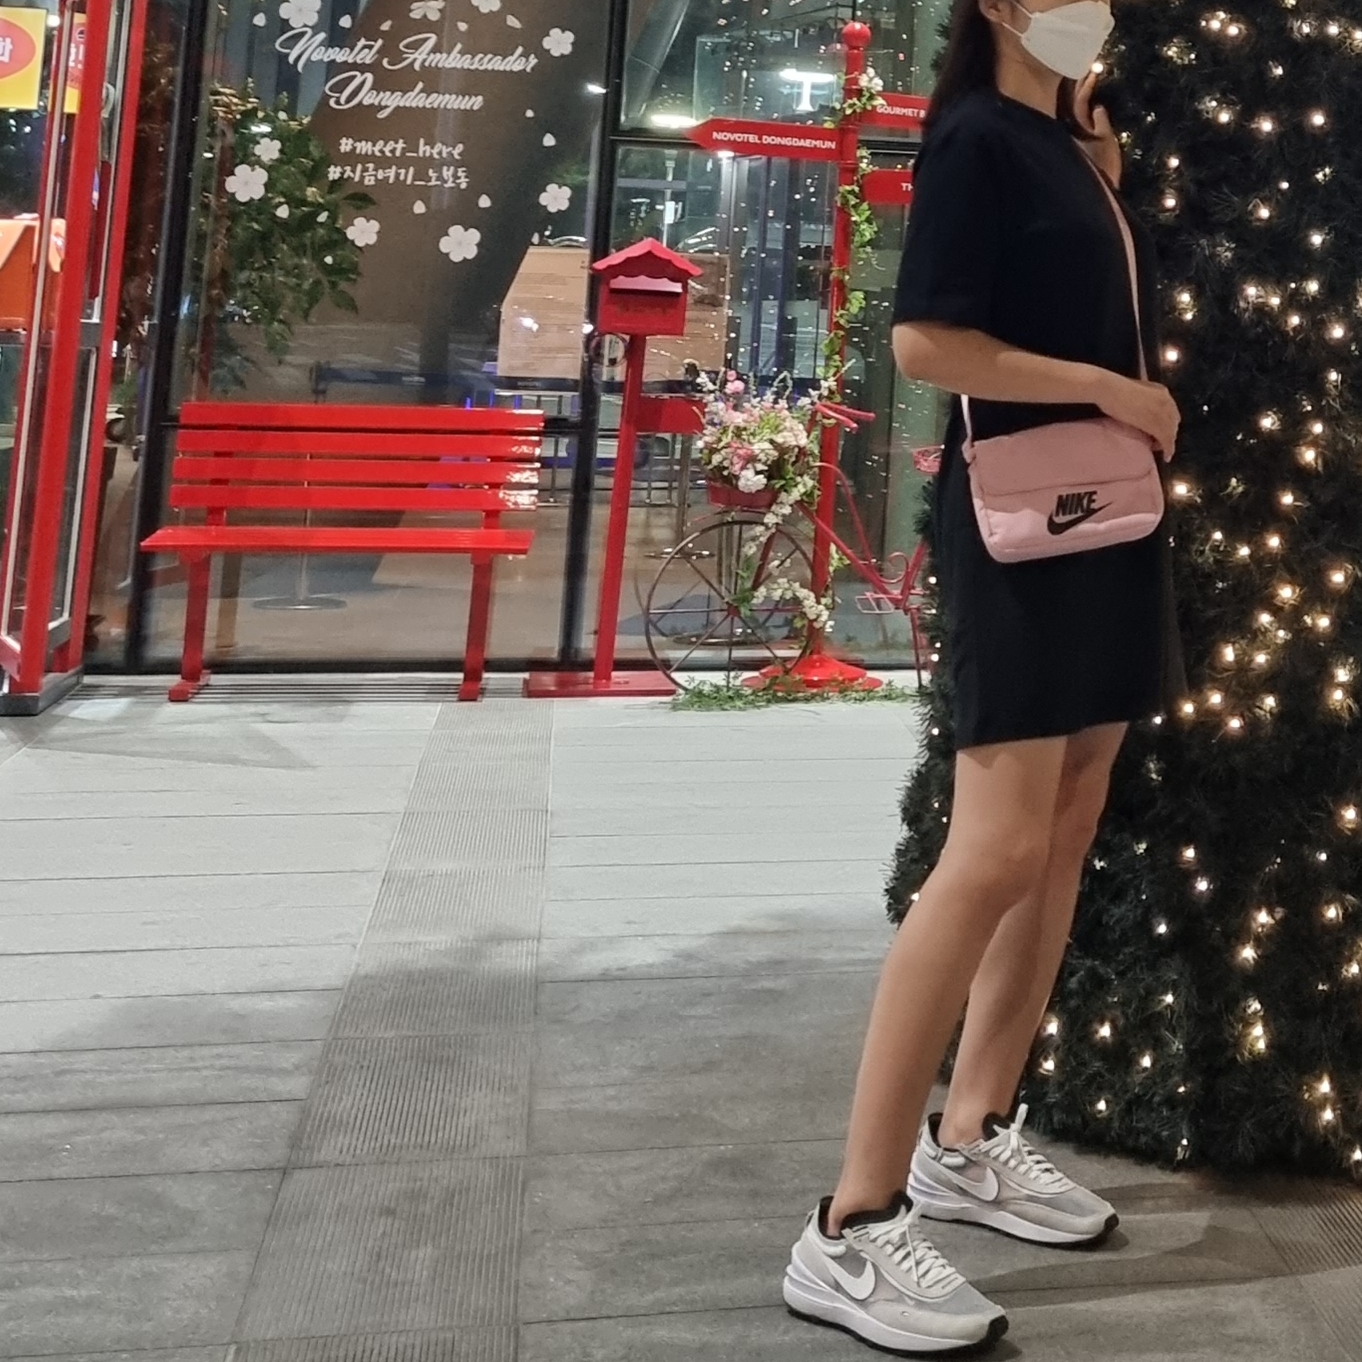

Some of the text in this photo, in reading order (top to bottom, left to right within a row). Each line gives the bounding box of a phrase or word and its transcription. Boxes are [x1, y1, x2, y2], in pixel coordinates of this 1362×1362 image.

[275, 27, 539, 73] Novotel Ambassador
[324, 71, 484, 119] Dongdaemun
[876, 105, 919, 118] GOURMET
[338, 137, 465, 160] #meet_here
[712, 131, 837, 150] NOVOTEL DONGDAEMUN
[1054, 490, 1098, 518] NIKE
